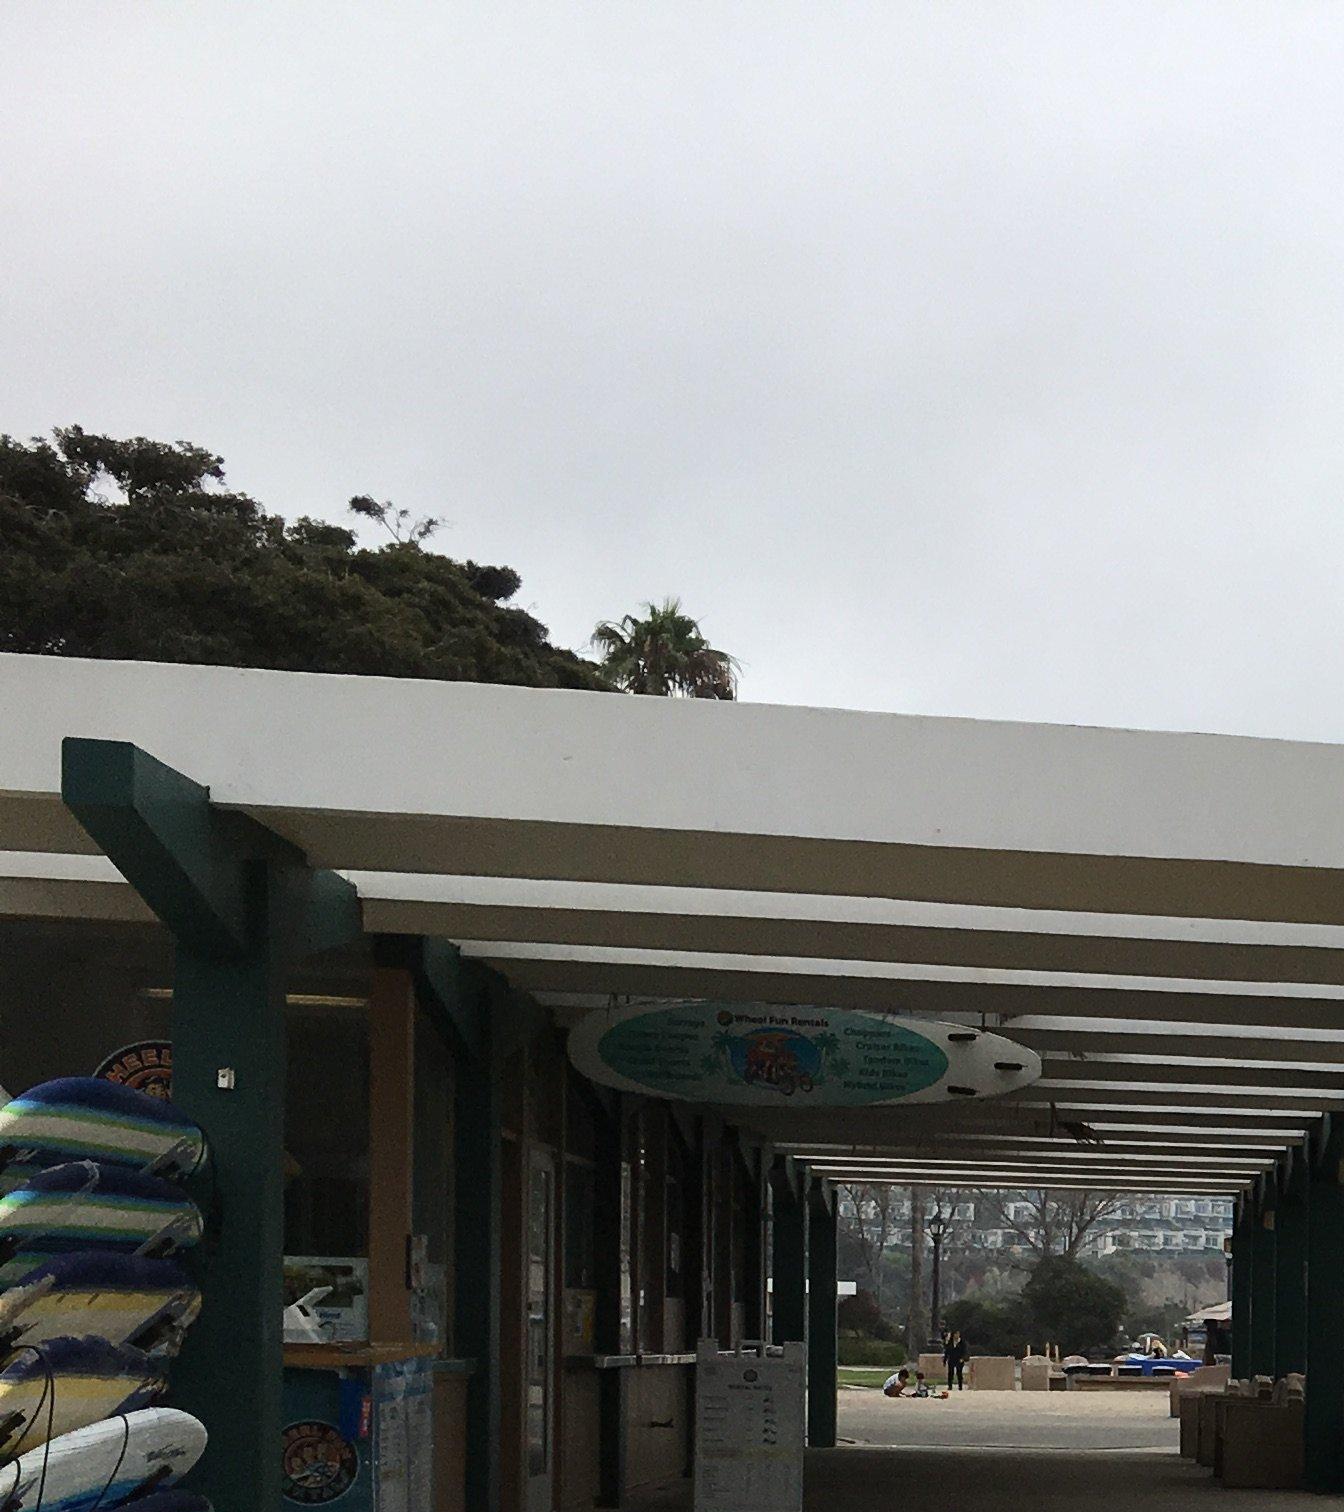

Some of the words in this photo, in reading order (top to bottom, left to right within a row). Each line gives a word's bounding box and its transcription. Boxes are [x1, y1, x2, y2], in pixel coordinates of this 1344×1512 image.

[735, 1014, 767, 1025] Wheel
[769, 1016, 788, 1025] Fun
[791, 1016, 829, 1028] Rentals
[105, 1048, 173, 1084] HEEL
